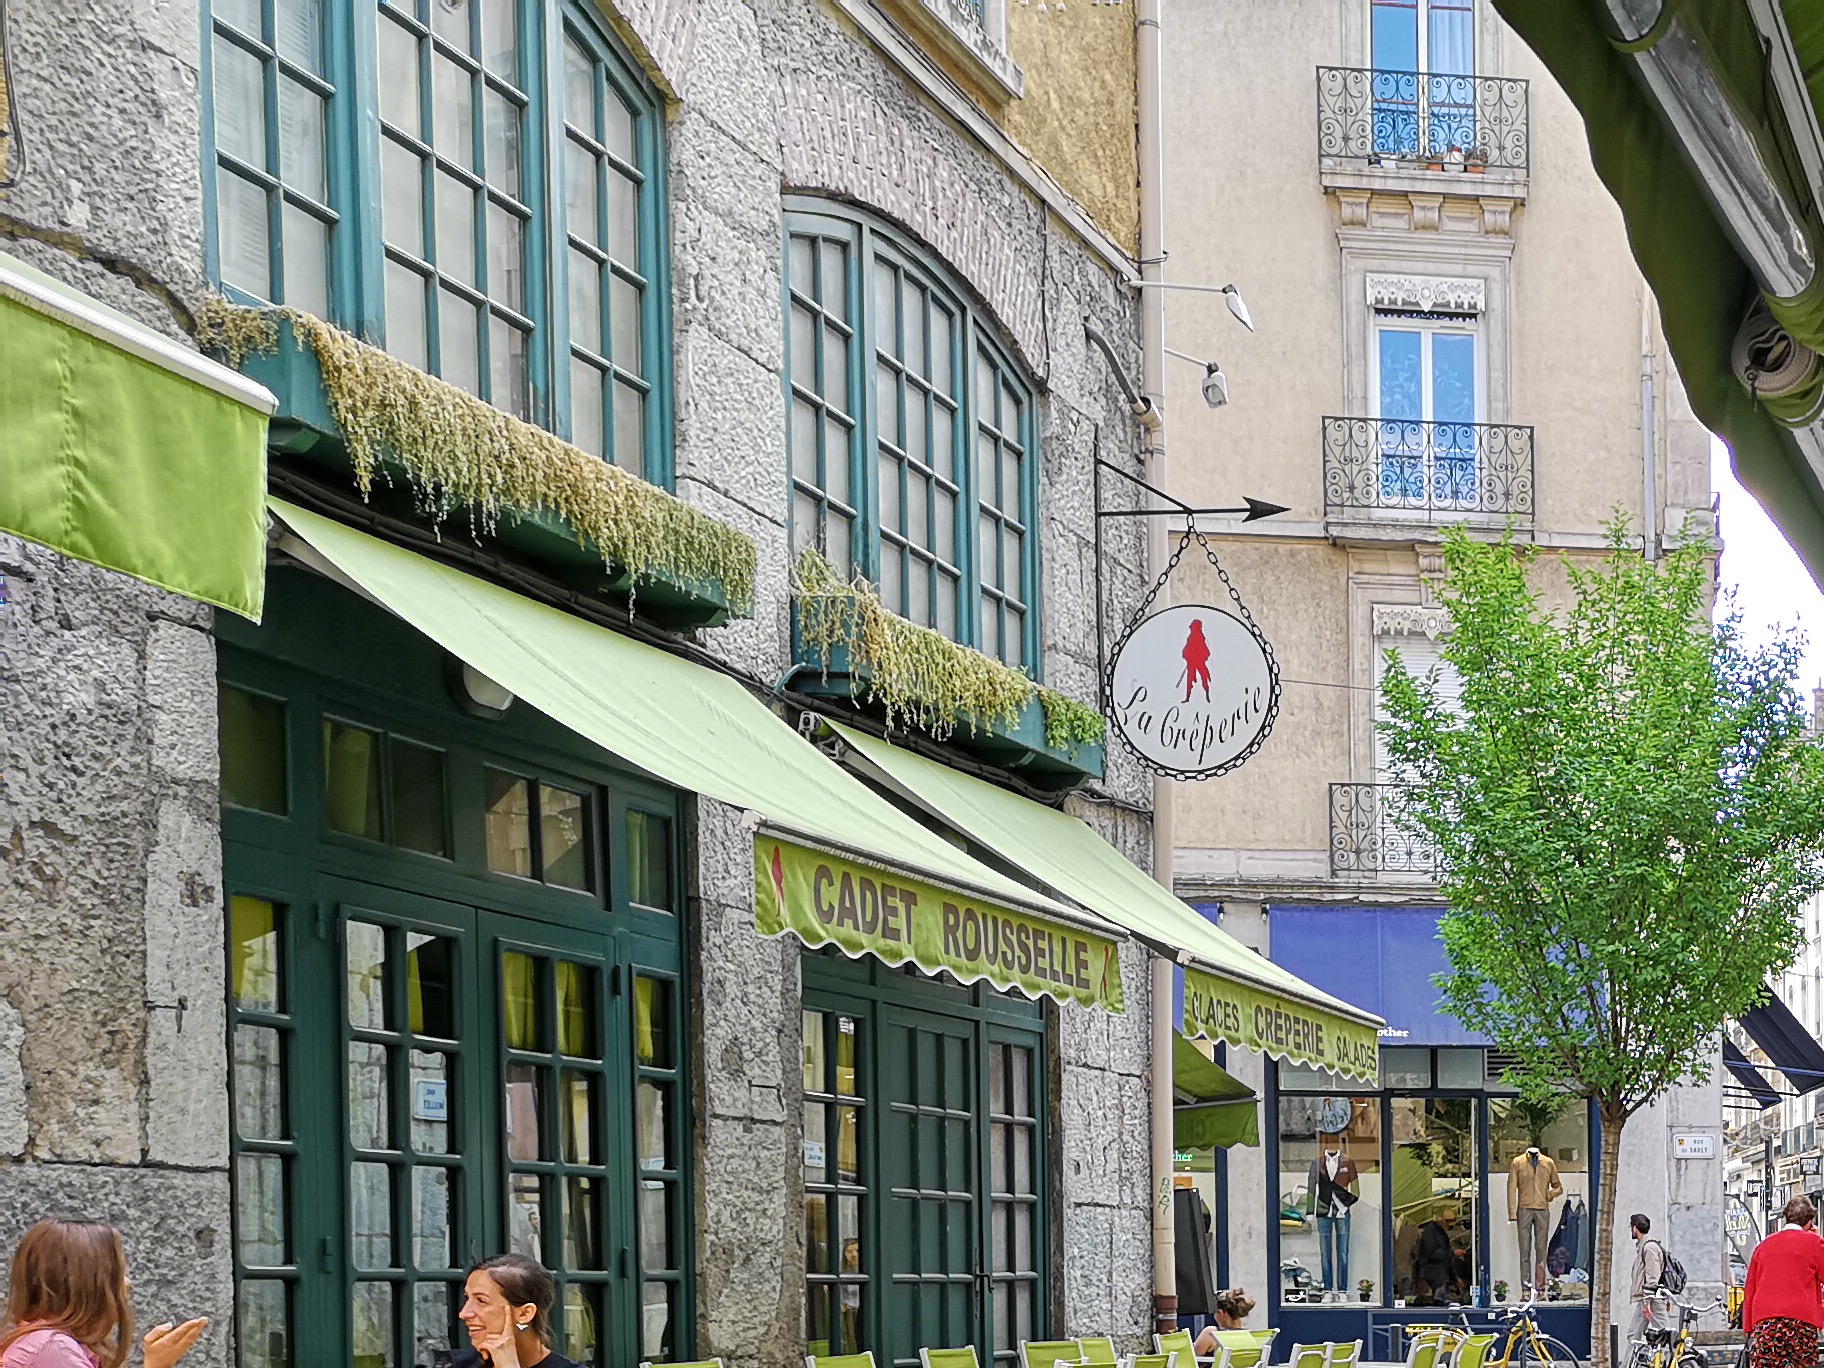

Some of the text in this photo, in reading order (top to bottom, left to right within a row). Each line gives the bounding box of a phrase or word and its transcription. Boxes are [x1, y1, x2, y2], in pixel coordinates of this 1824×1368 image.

[1117, 684, 1263, 766] La Crêperie
[813, 864, 1091, 991] CADET ROUSSELLE
[1192, 990, 1377, 1072] GLACES CRÊPERIE SALADES
